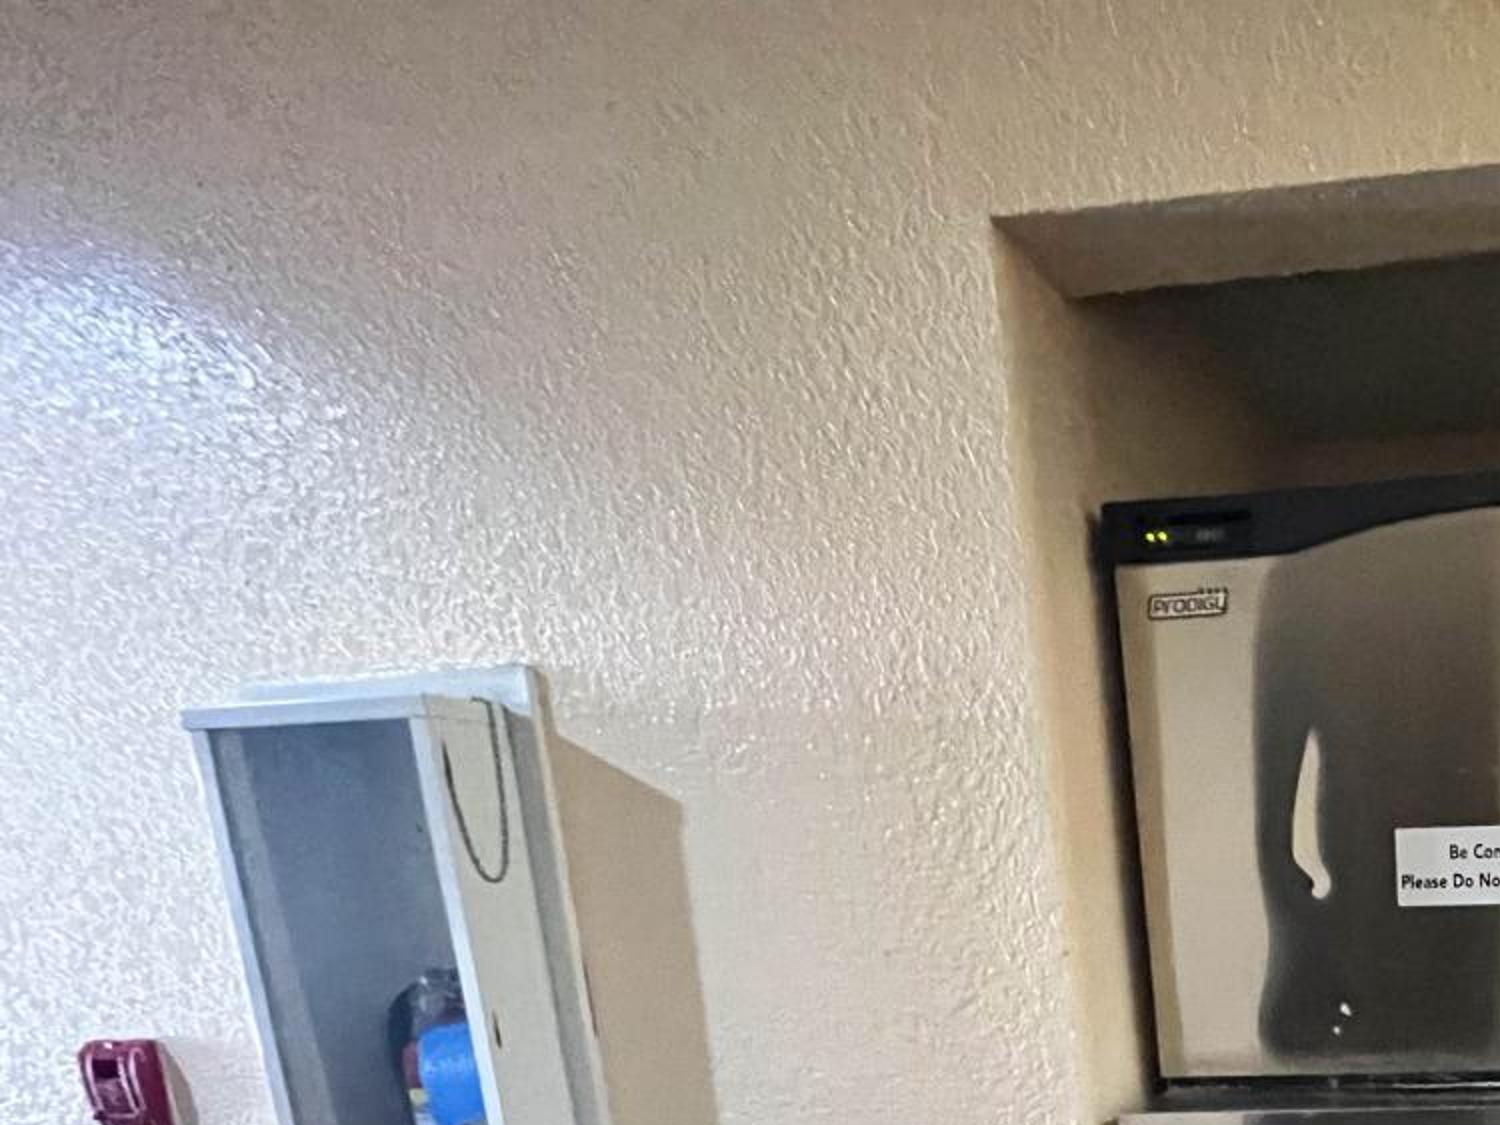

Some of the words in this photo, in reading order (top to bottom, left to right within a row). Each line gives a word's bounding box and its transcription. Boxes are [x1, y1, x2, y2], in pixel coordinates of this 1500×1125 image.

[1449, 843, 1468, 859] Be
[1401, 873, 1447, 889] Please
[1453, 873, 1474, 888] Do
